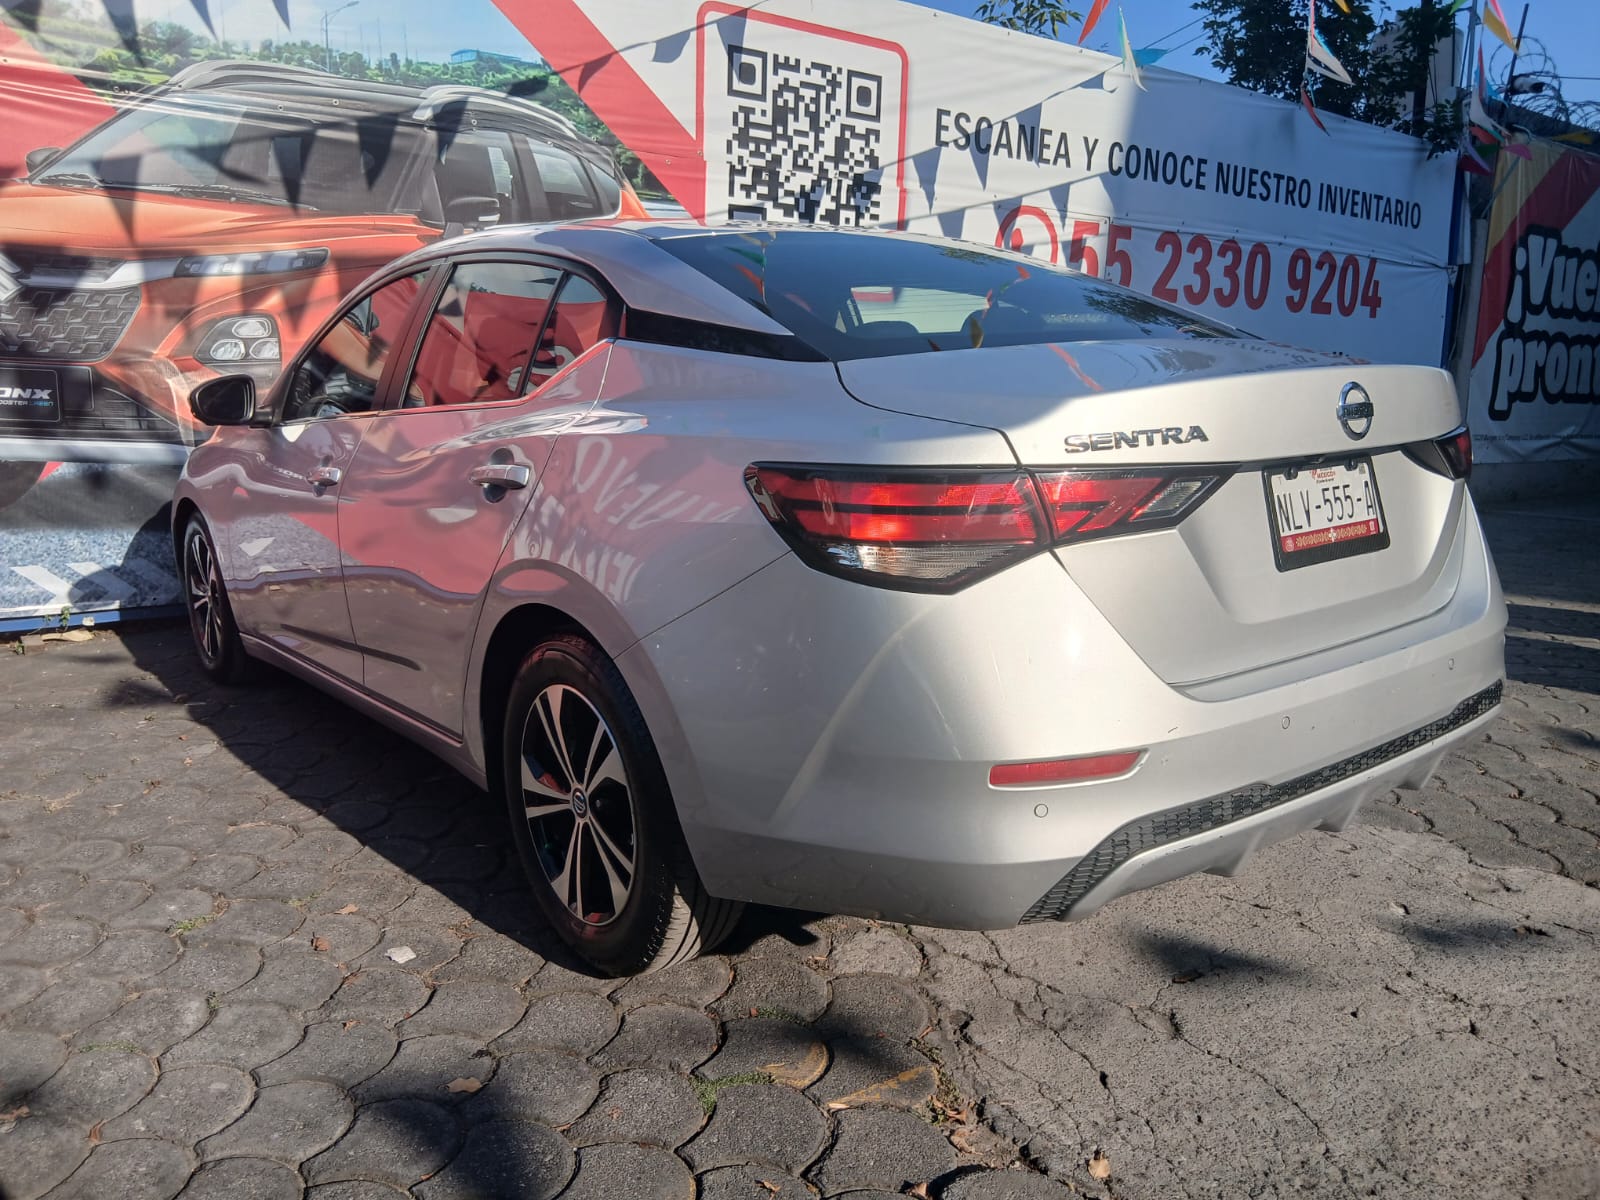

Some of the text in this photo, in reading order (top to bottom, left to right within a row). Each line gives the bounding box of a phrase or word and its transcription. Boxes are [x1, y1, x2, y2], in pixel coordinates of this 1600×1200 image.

[935, 108, 1422, 229] ESCANEA Y CONOCE NUESTRO INVENTARIO
[1070, 220, 1382, 318] 55 2330 9204
[1505, 230, 1600, 325] ¡Vue
[1064, 425, 1209, 453] SENTRA
[1277, 481, 1376, 533] NLV-555-A
